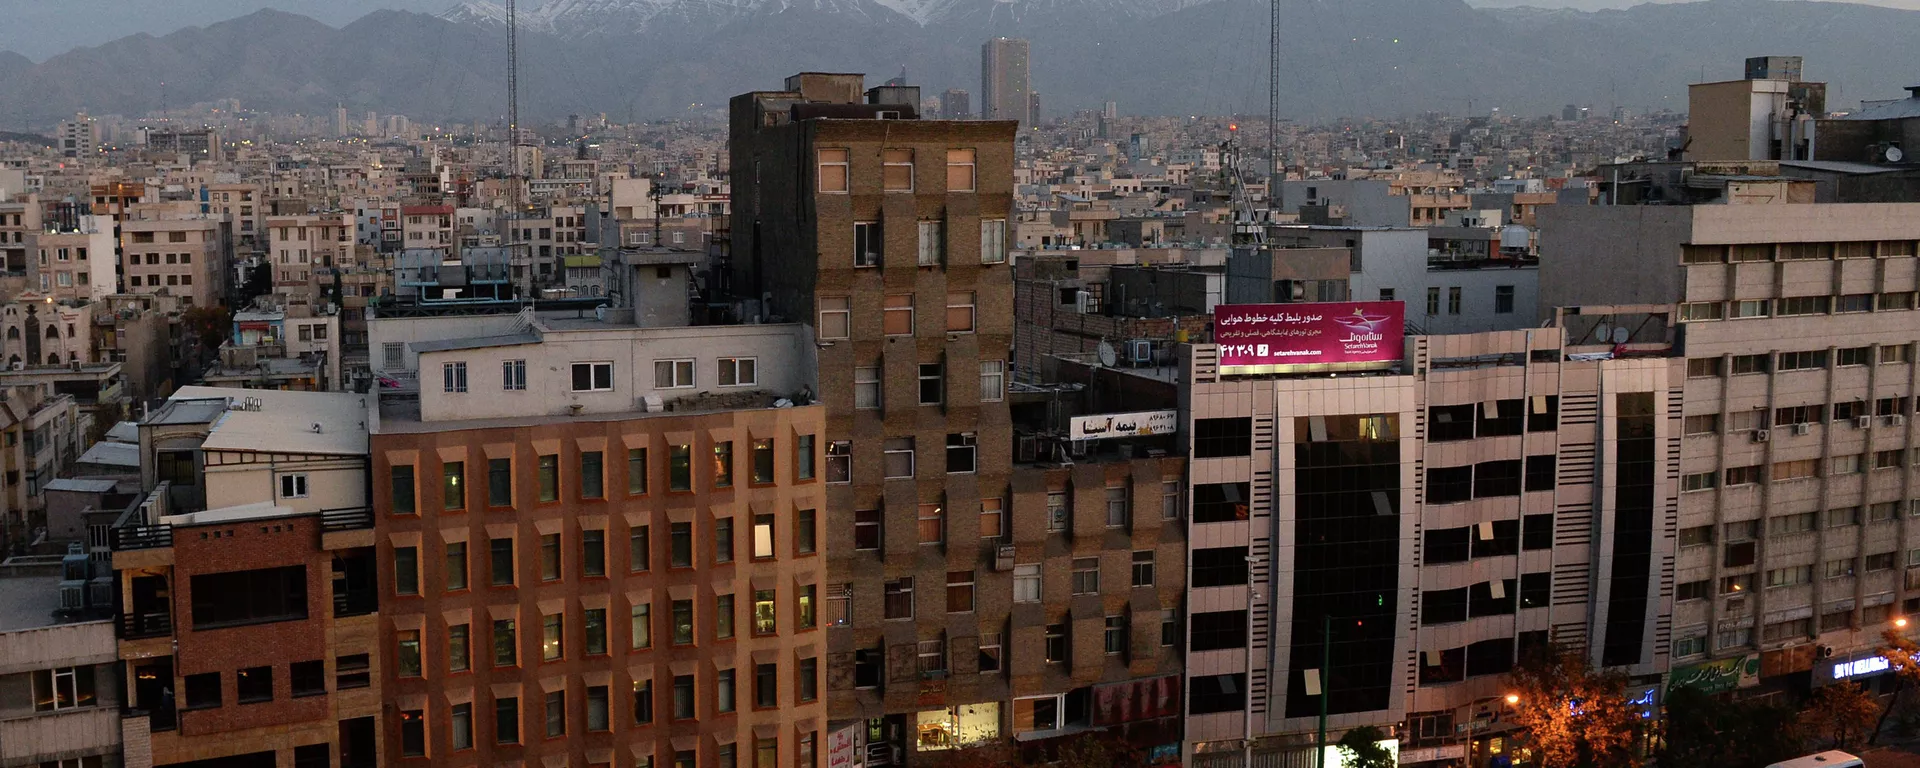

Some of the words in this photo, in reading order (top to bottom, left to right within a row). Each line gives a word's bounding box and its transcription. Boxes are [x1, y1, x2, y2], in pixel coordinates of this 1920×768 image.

[1220, 313, 1243, 326] هوایی
[1244, 312, 1268, 325] خطوط
[1269, 312, 1285, 325] کلیه
[1285, 312, 1302, 324] بلیط
[1302, 314, 1323, 323] صدور
[1273, 349, 1322, 357] setarehvanak.com
[1115, 421, 1137, 435] بیمه
